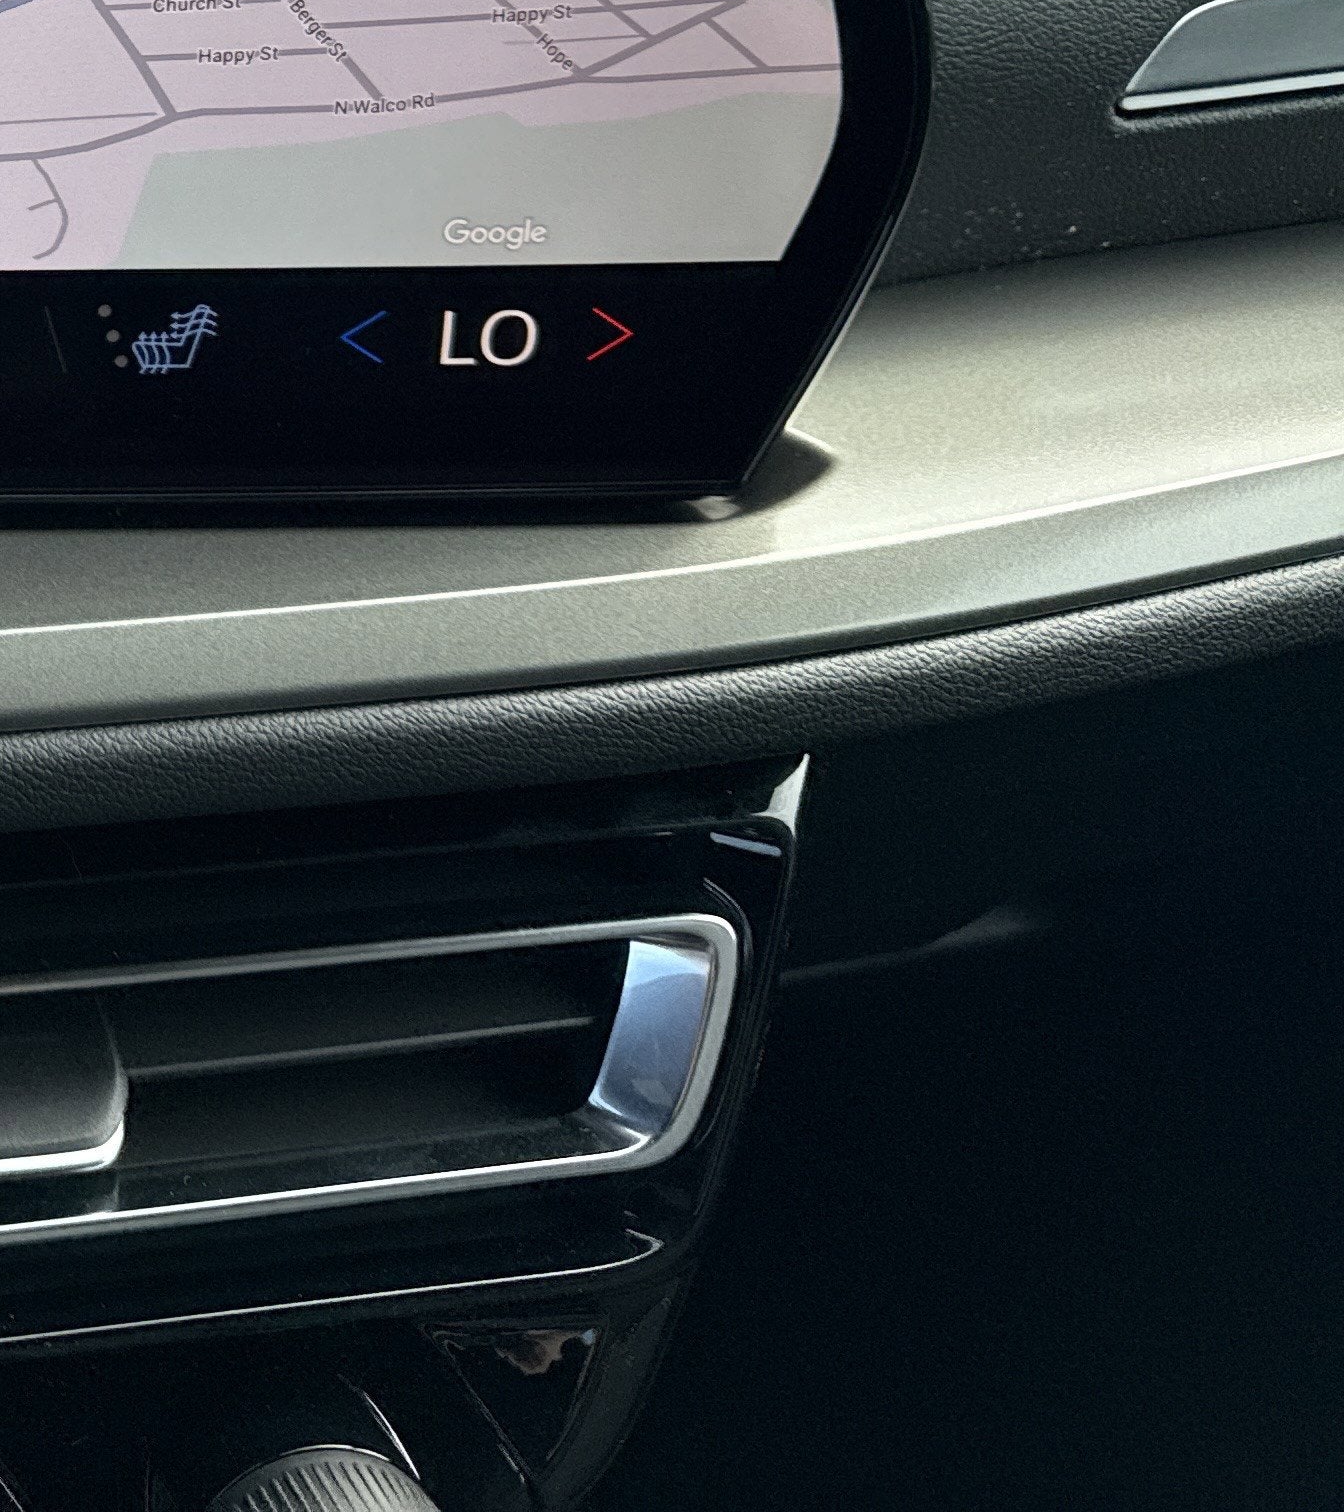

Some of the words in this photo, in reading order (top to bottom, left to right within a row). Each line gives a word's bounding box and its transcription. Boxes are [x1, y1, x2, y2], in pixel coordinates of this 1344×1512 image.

[492, 7, 547, 25] Happy
[552, 4, 572, 19] St
[291, 0, 334, 49] Berger
[325, 38, 348, 63] St
[198, 48, 253, 66] Happy
[258, 46, 278, 62] St
[536, 31, 574, 72] Hope
[334, 101, 347, 114] N
[354, 98, 406, 114] Walco
[412, 94, 434, 109] Rd
[444, 219, 547, 248] Google
[439, 312, 540, 366] LO
